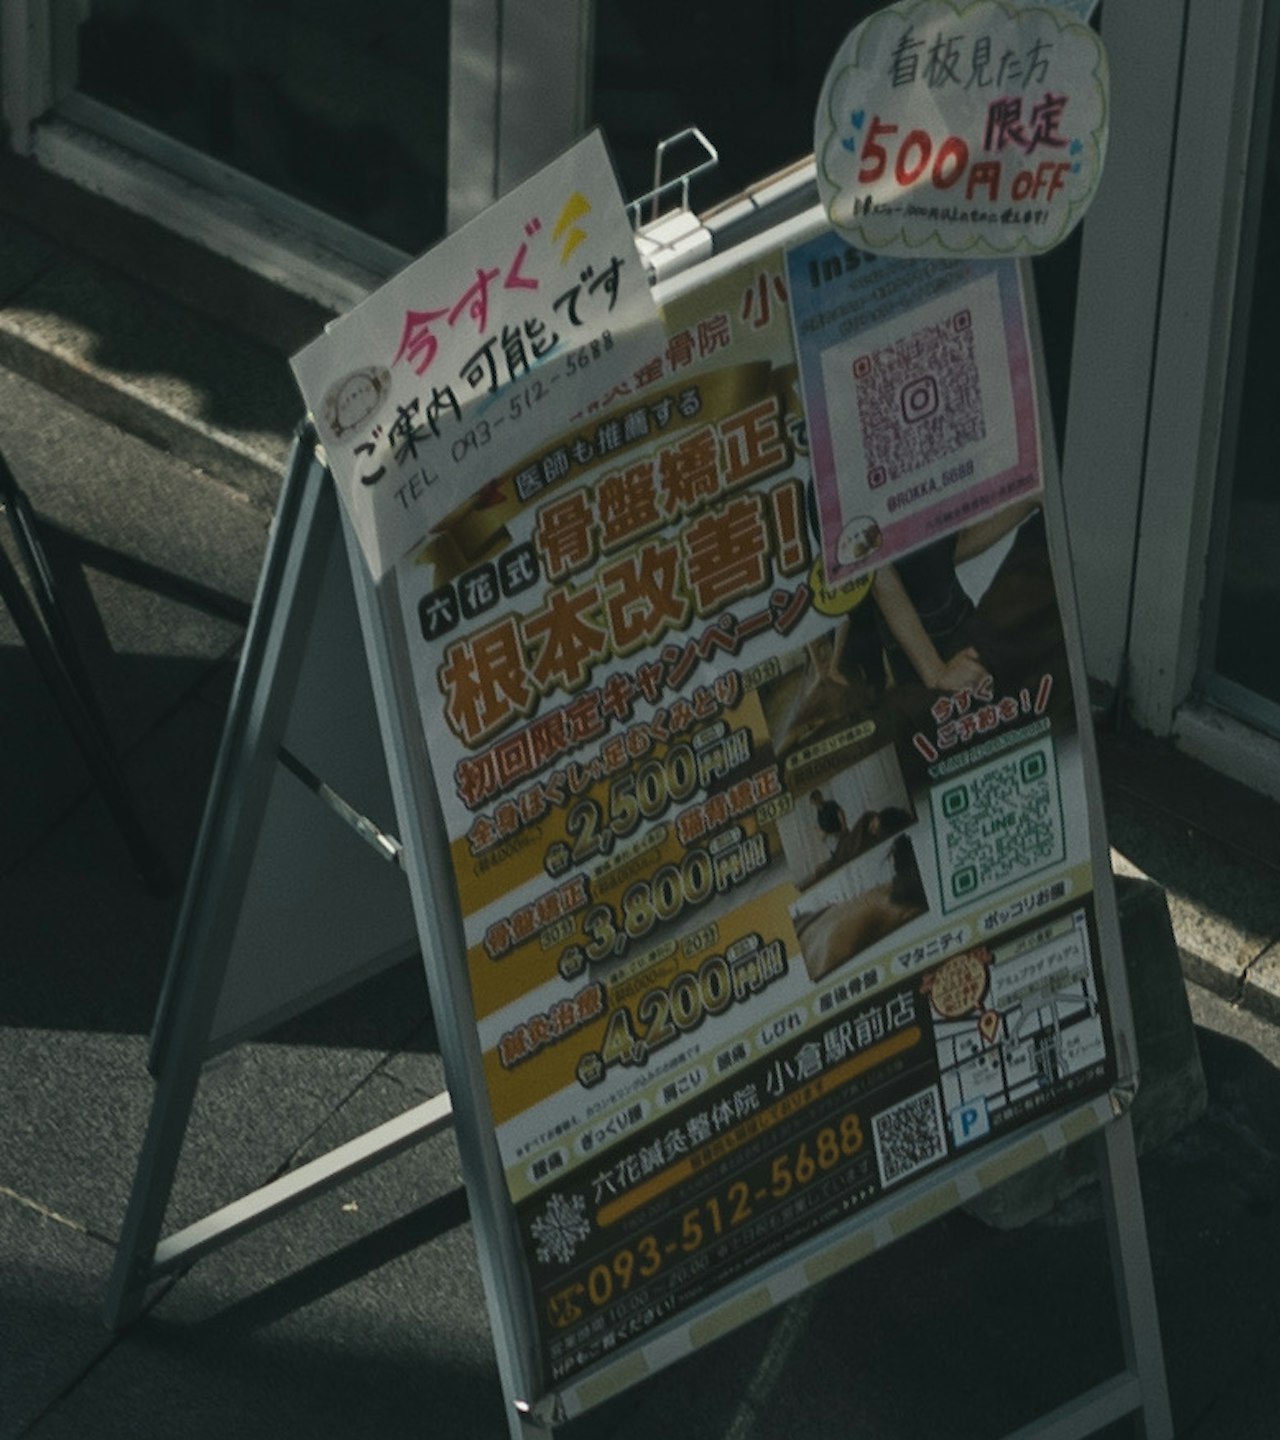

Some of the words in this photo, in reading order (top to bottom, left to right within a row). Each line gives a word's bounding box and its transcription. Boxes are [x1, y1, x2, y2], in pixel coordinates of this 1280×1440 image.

[888, 28, 1056, 90] 看板見た方
[981, 94, 1072, 153] 限定
[855, 115, 1001, 204] 500円
[393, 213, 547, 380] 今すぐ
[393, 468, 443, 513] TEL
[450, 328, 620, 460] 093-512-5688
[513, 388, 704, 500] 医師も推薦する
[533, 393, 788, 585] 骨盤矯正
[437, 474, 811, 747] 根本改善!
[454, 578, 812, 811] 初回限定キャンペーン
[982, 811, 1018, 841] LINE
[661, 1064, 703, 1104] 肩こり
[759, 1006, 803, 1048] しびれ
[896, 924, 966, 976] マタニティ
[763, 984, 917, 1103] 小倉駅前店
[585, 1107, 866, 1310] 093-512-5688
